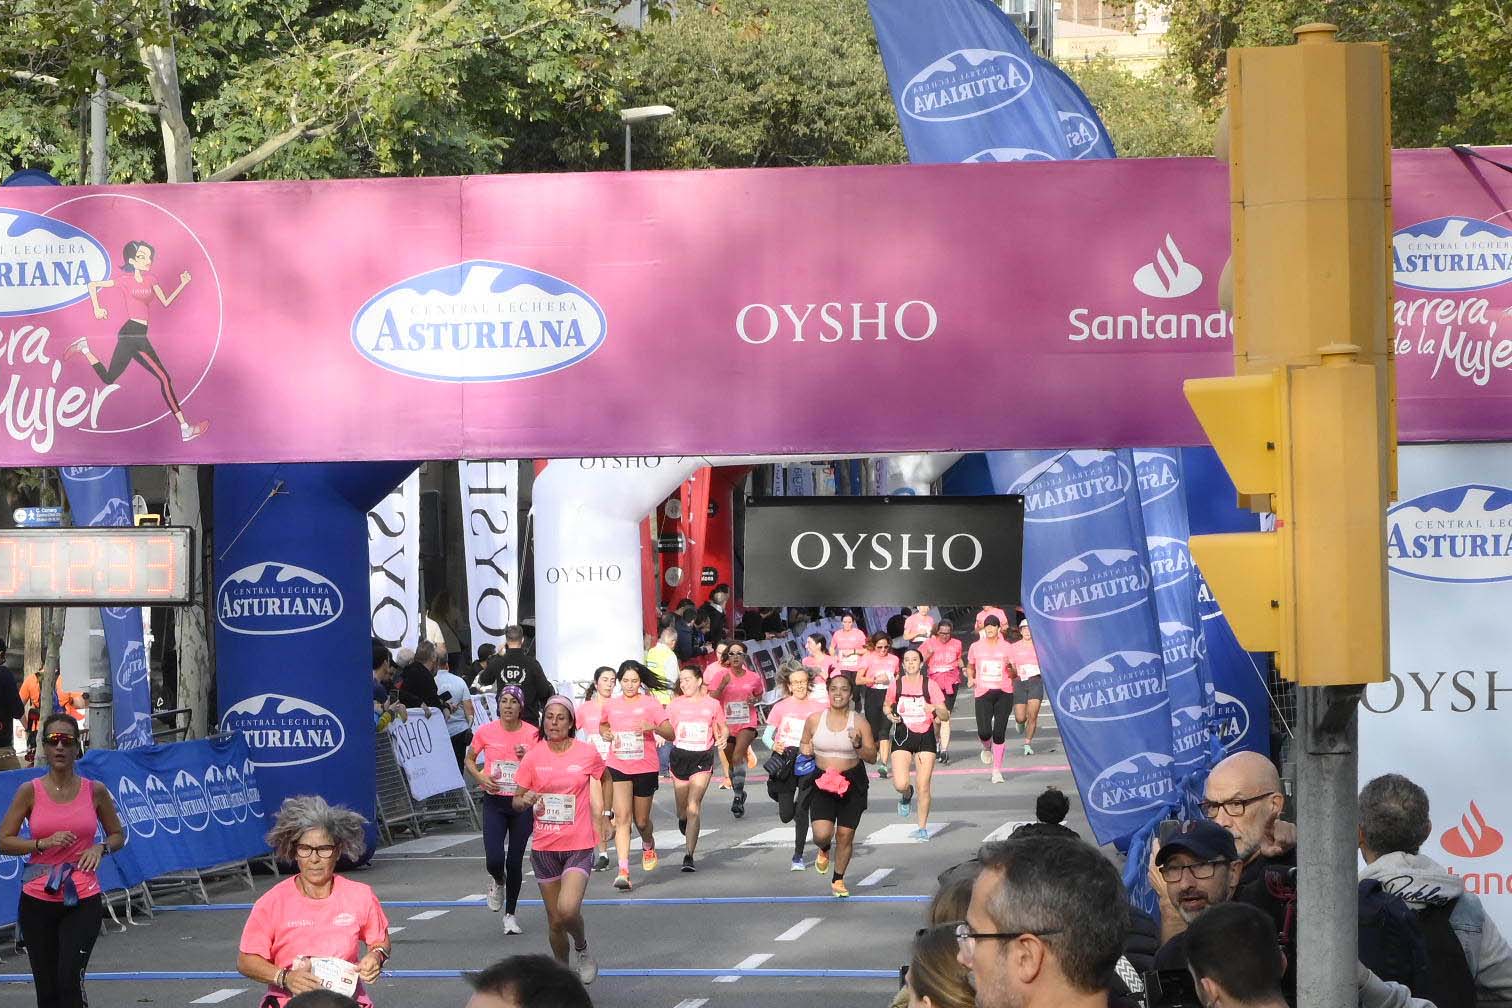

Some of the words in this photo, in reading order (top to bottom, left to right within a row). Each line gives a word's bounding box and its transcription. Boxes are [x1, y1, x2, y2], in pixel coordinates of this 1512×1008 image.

[14, 243, 86, 256] LECHERA
[1408, 241, 1460, 252] CENTRAL
[1464, 240, 1510, 251] LECHER
[409, 302, 488, 316] CENTRAL
[497, 300, 578, 314] LECHERA
[1393, 297, 1489, 326] arrera
[371, 307, 586, 352] ASTURIANA
[735, 300, 938, 345] OYSHO
[1068, 307, 1234, 341] Santand
[1418, 327, 1435, 354] la
[1431, 325, 1512, 387] Muje
[1415, 518, 1483, 531] CENTRAL
[790, 531, 983, 572] OYSHO
[546, 564, 623, 585] OYSHO
[233, 587, 277, 596] CENTRAL
[280, 586, 329, 595] LECHERA
[220, 591, 334, 619] ASTURIANA
[507, 670, 520, 679] BP
[236, 719, 278, 727] CENTRAL
[281, 718, 330, 726] LECHERA
[243, 729, 335, 749] TURIANA
